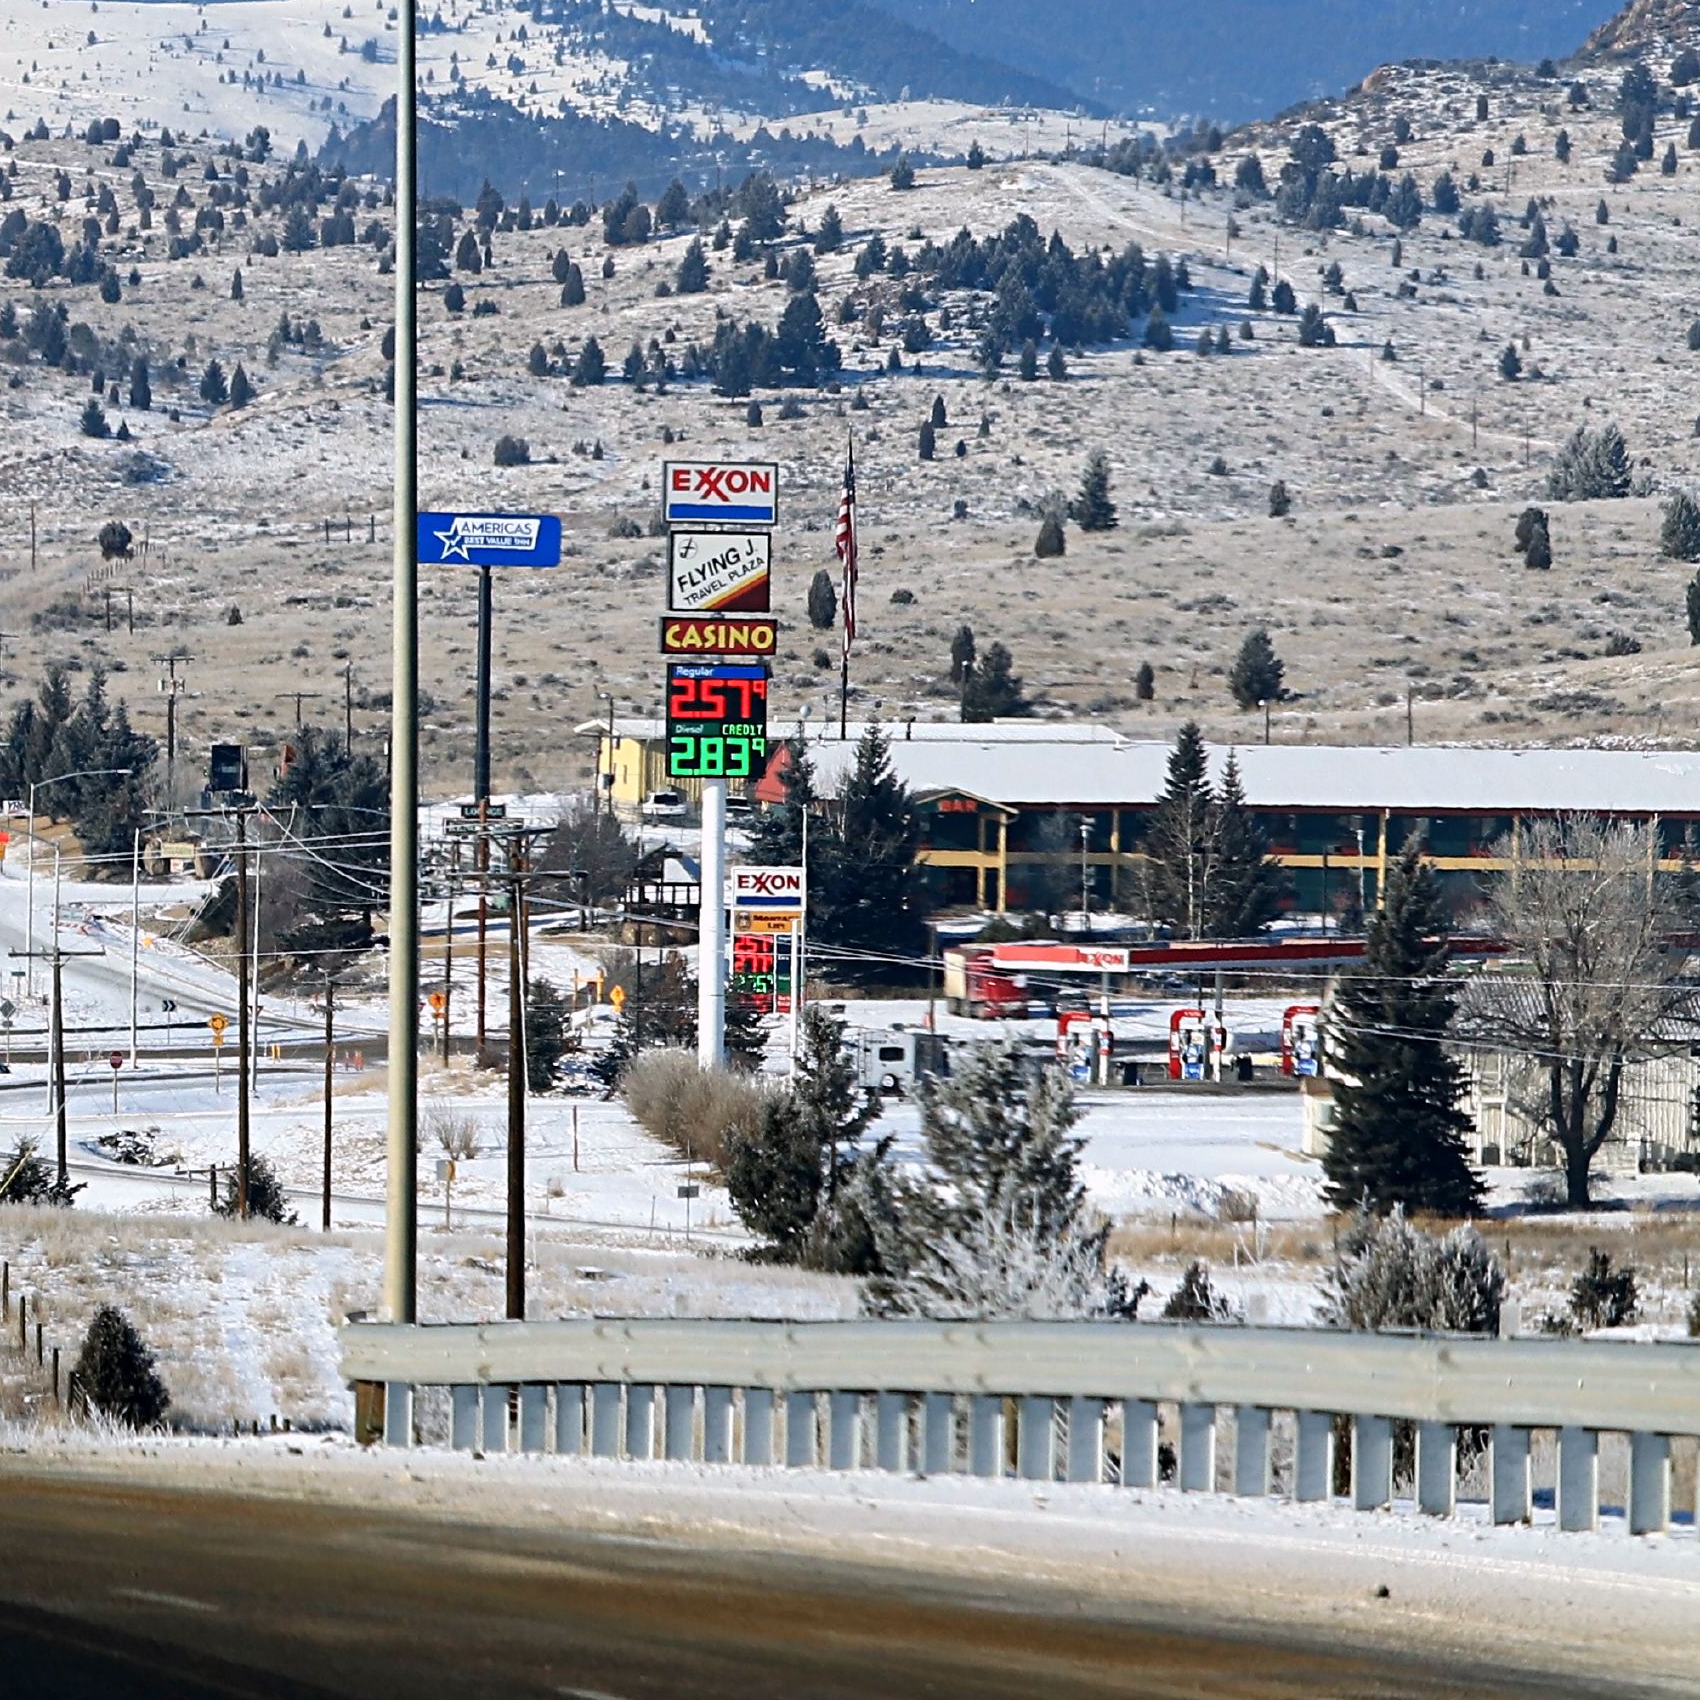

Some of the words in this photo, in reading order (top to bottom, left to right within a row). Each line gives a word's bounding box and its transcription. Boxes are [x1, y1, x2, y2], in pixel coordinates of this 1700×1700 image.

[672, 466, 770, 502] EXXON
[461, 522, 532, 535] AMERICAS
[464, 536, 484, 545] BEST
[486, 537, 512, 546] VALUE
[514, 537, 530, 546] INN
[677, 547, 741, 593] FLYING
[683, 578, 728, 606] TRAVEL
[728, 556, 766, 583] PLAZA
[665, 624, 774, 649] CASINO
[676, 666, 714, 678] Regular
[675, 724, 704, 734] Diesel
[722, 724, 763, 736] CREDIT
[737, 872, 800, 895] EXXON
